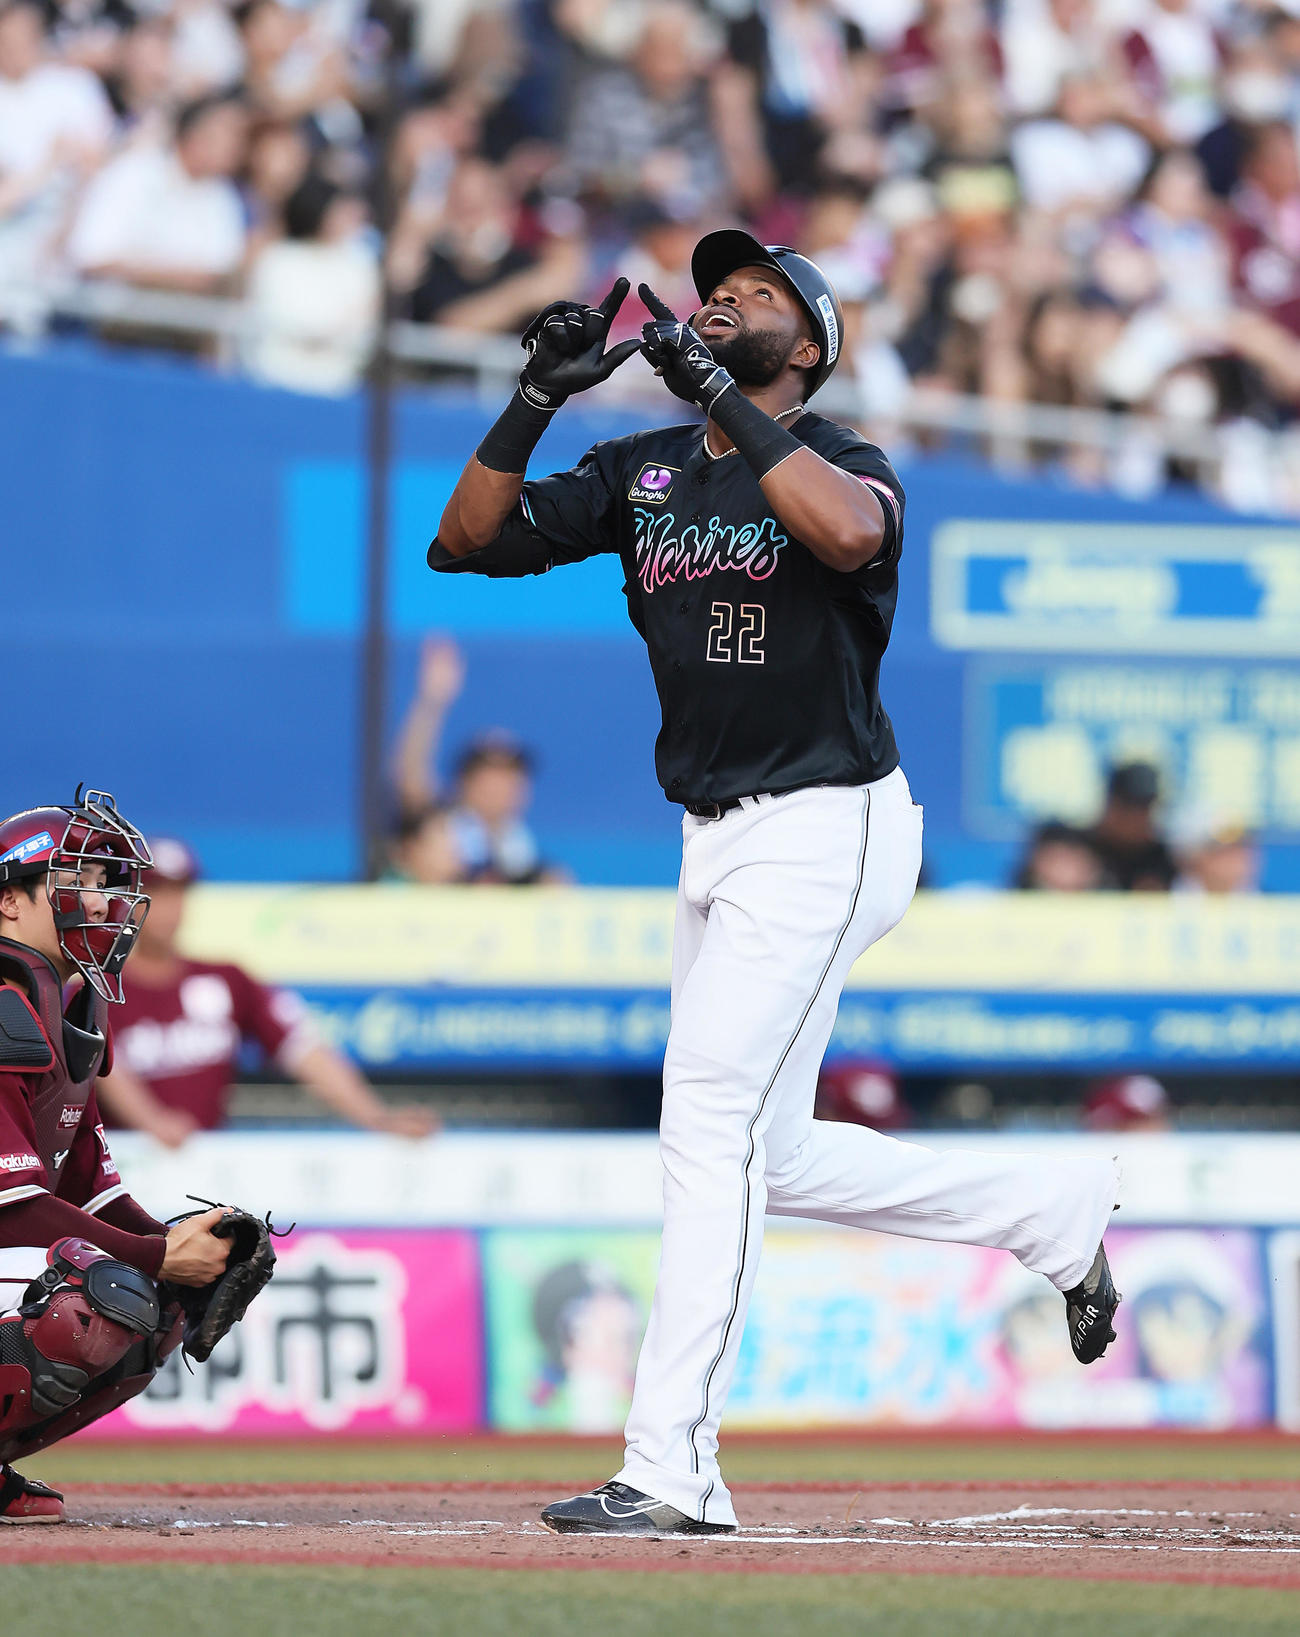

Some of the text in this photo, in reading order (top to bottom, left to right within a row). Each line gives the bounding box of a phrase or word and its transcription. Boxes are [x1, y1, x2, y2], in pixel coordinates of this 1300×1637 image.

[631, 487, 665, 500] GungHo
[634, 508, 788, 593] Marines
[706, 601, 766, 665] 22
[60, 1107, 82, 1123] Rakute
